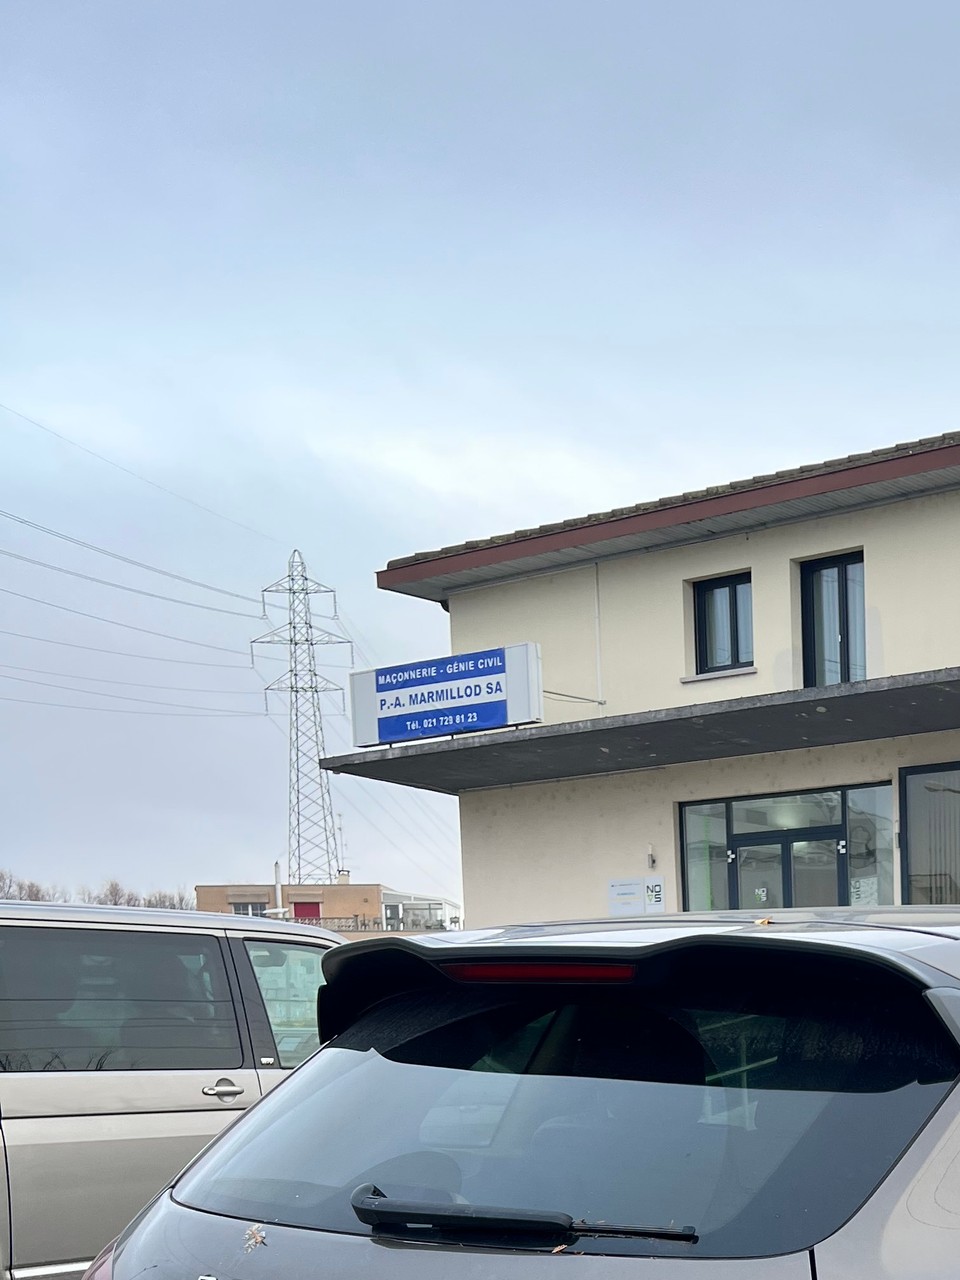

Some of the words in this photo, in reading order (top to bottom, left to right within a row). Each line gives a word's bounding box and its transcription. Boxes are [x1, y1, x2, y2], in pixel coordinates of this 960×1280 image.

[378, 667, 436, 685] MAÇONNERIE
[446, 660, 475, 674] GÉNIE
[478, 656, 502, 669] CIVIL
[380, 696, 405, 711] P.-A.
[409, 684, 482, 706] MARMILLOD
[486, 681, 502, 695] SA
[406, 720, 421, 731] Tél.
[423, 718, 436, 728] 021
[455, 714, 464, 724] 81
[468, 712, 478, 722] 23
